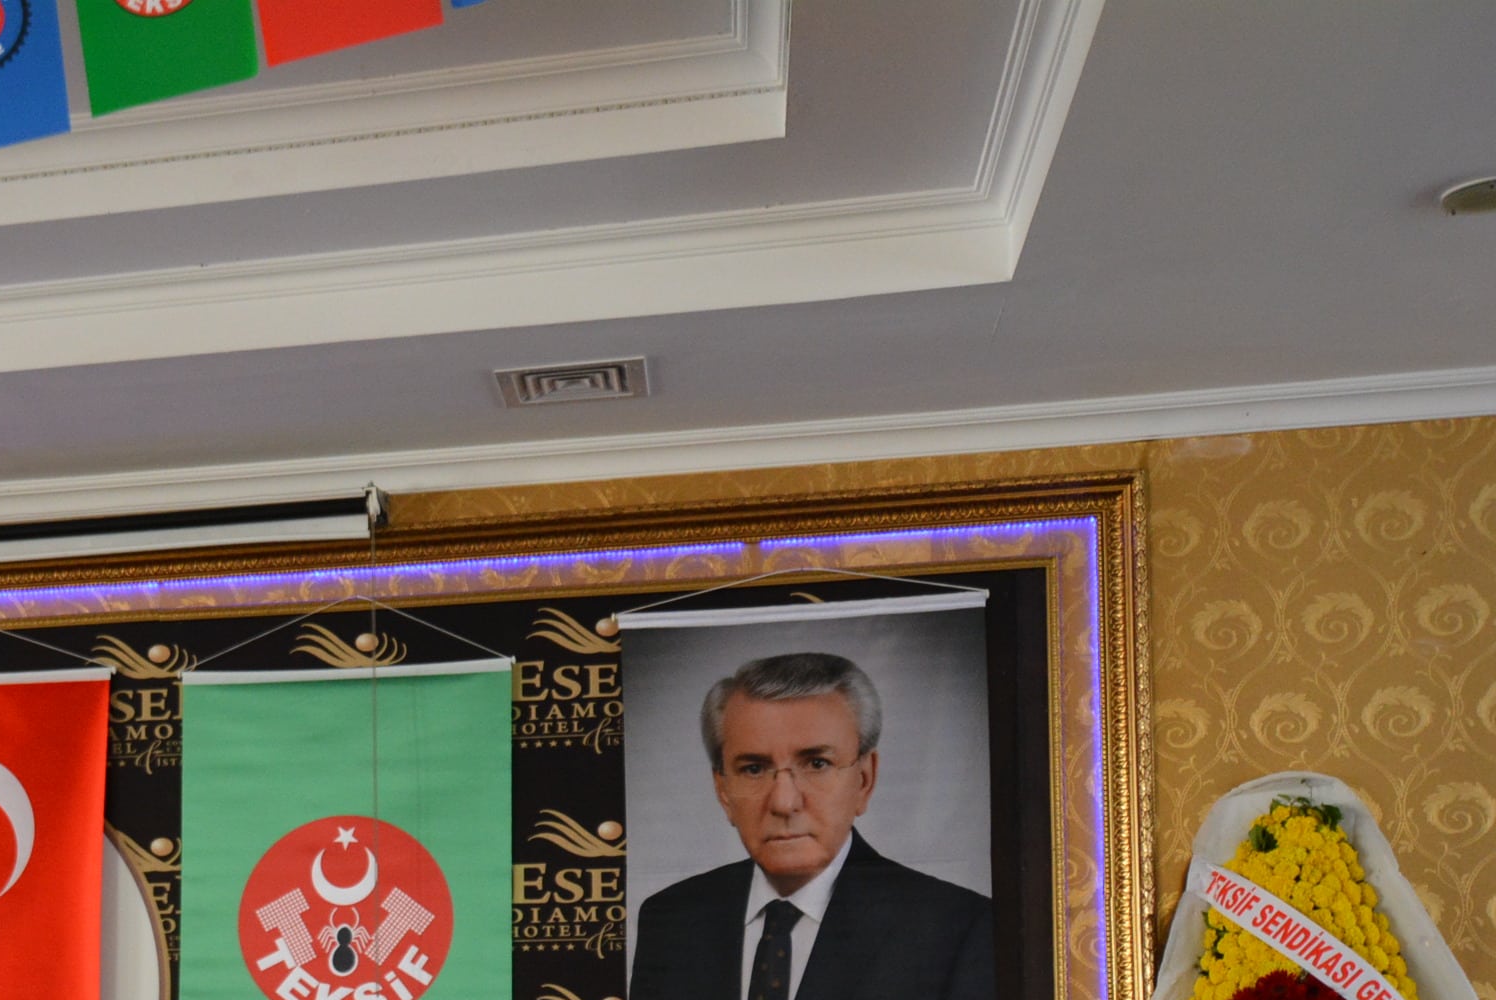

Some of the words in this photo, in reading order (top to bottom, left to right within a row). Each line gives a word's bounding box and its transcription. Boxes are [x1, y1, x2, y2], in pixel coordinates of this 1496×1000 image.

[512, 661, 622, 701] ESE
[512, 701, 624, 721] DIAMO
[512, 863, 625, 904] ESE
[512, 905, 626, 923] DIAMO
[1251, 903, 1364, 990] SENDİKASI
